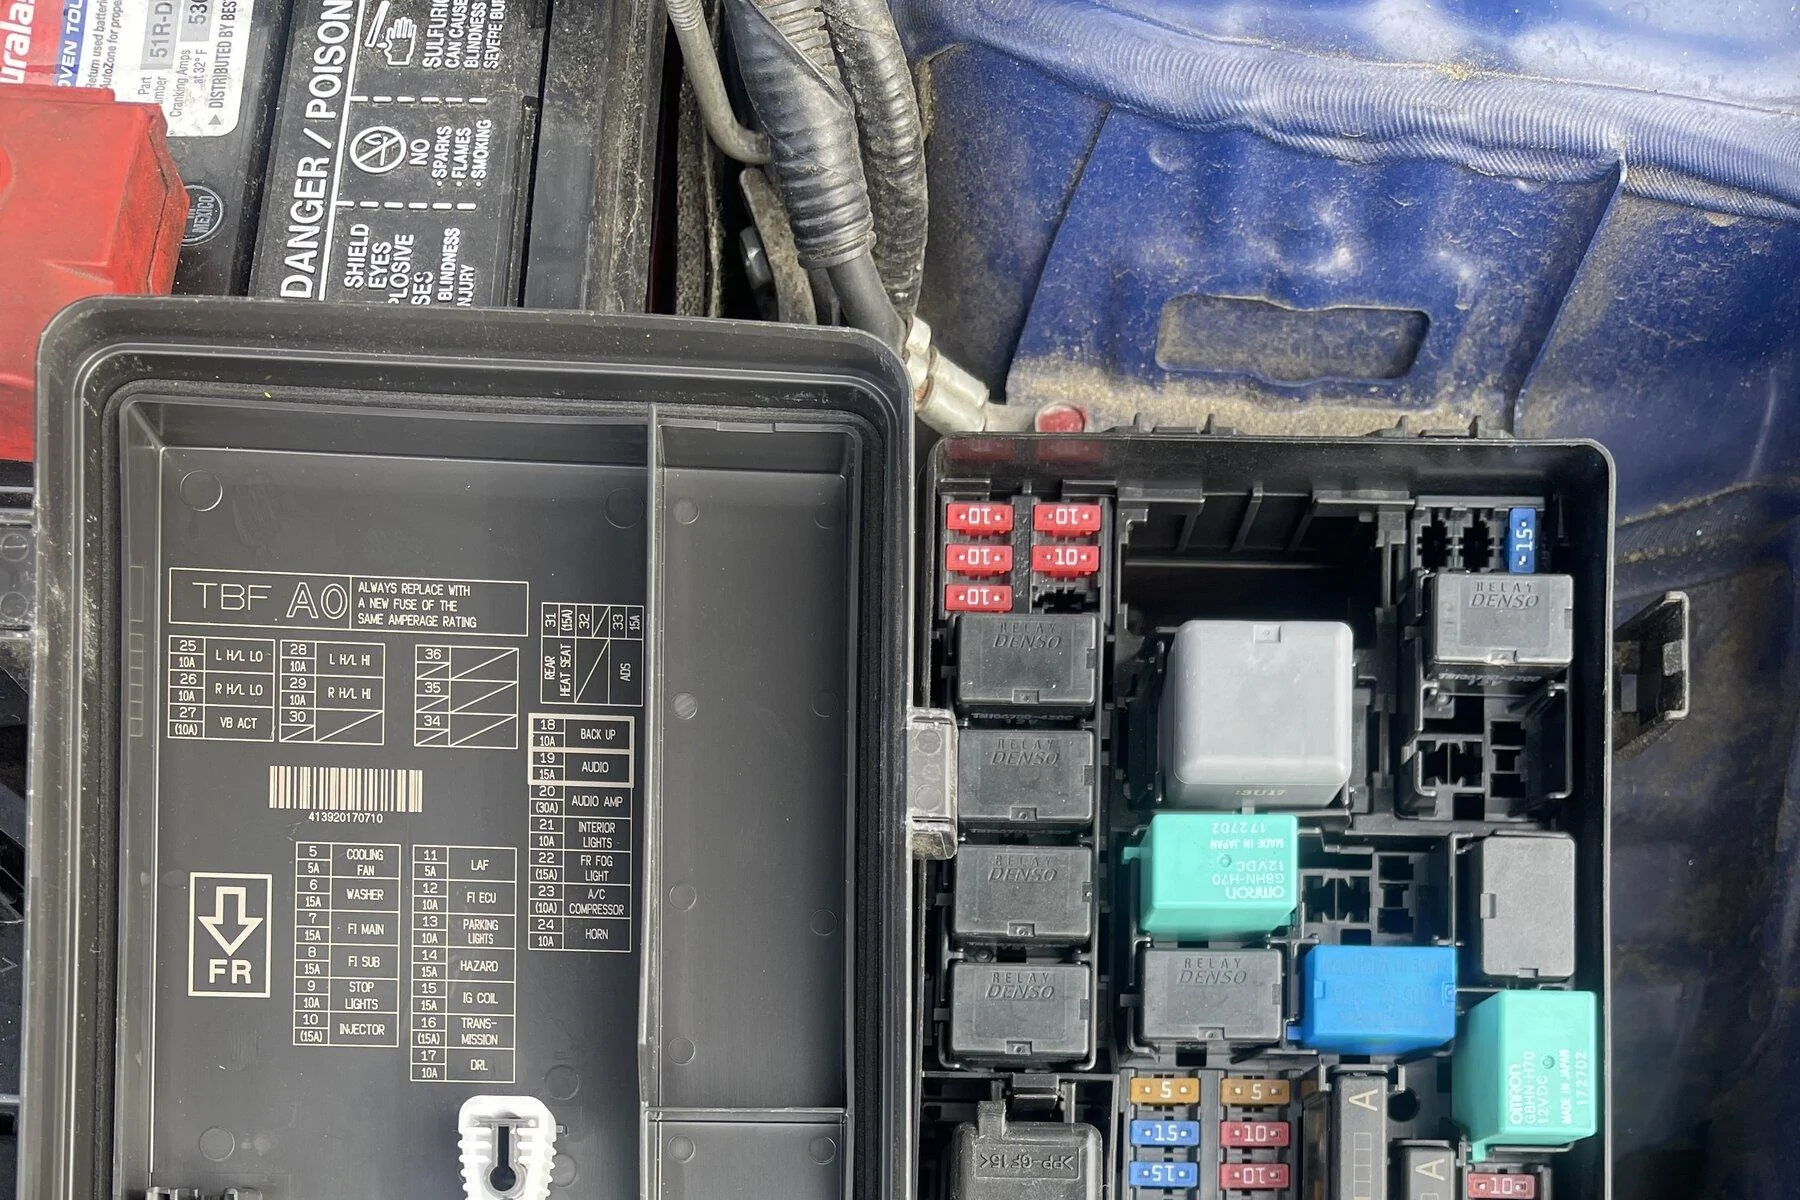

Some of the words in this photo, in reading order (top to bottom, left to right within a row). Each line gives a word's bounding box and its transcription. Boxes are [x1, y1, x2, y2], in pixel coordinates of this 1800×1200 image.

[221, 0, 237, 20] BES
[107, 30, 118, 43] for
[219, 24, 233, 37] BY
[463, 2, 486, 68] BLINDNESS
[0, 0, 35, 84] urala
[93, 35, 103, 56] used
[483, 24, 502, 69] SEVERE
[176, 50, 192, 73] Amps
[445, 42, 462, 68] CAN
[209, 41, 231, 108] DISTRIBUTED
[138, 77, 152, 94] Part
[170, 77, 188, 117] Cranking
[281, 156, 330, 298] DANGER
[306, 0, 351, 119] POISON
[410, 139, 430, 165] NO
[432, 126, 452, 178] SPARKS
[452, 128, 471, 178] FLAMES
[471, 119, 491, 178] SMOKING
[192, 195, 214, 233] MEXICO
[344, 224, 369, 288] SHIELD
[368, 242, 392, 289] EYES
[438, 228, 460, 301] BLINDNESS
[457, 264, 474, 306] NJURY
[968, 508, 990, 524] 10
[1056, 509, 1078, 524] 10
[1516, 529, 1532, 551] 15
[1054, 549, 1077, 565] 10
[192, 582, 272, 610] TBF
[359, 582, 397, 594] ALWAYS
[402, 583, 443, 595] REPLACE
[449, 584, 470, 596] WITH
[967, 589, 989, 605] 10
[1471, 594, 1539, 608] DENSO
[358, 598, 364, 608] A
[370, 599, 388, 610] NEW
[394, 599, 416, 610] FUSE
[422, 600, 434, 611] OF
[440, 601, 457, 612] THE
[358, 614, 383, 625] SAME
[388, 615, 439, 627] AMPERAGE
[443, 616, 476, 628] RATING
[562, 609, 573, 631] (15A)
[613, 614, 624, 630] 33
[180, 640, 196, 651] 25
[993, 634, 1063, 649] DENSO
[216, 650, 221, 661] L
[227, 650, 245, 662] H/L
[250, 651, 263, 662] LO
[330, 655, 335, 665] L
[340, 655, 357, 666] H/L
[362, 655, 370, 666] HI
[425, 650, 441, 660] 36
[560, 644, 571, 668] SEAT
[179, 657, 195, 668] 10A
[544, 656, 555, 680] REAR
[620, 663, 631, 682] ADS
[560, 671, 570, 696] HEAT
[180, 707, 196, 718] 27
[289, 711, 306, 722] 30
[175, 723, 197, 735] (10A)
[220, 717, 233, 728] VB
[238, 718, 257, 729] ACT
[541, 720, 555, 730] 18
[581, 729, 601, 740] BACK
[606, 729, 616, 740] UP
[991, 751, 1060, 766] DENSO
[582, 762, 609, 773] AUDIO
[572, 796, 599, 807] AUDIO
[604, 797, 623, 808] AMP
[308, 813, 383, 823] 413920170710
[579, 822, 615, 833] INTERIOR
[583, 837, 612, 848] LIGHTS
[1210, 839, 1239, 849] JAPAN
[1244, 839, 1253, 848] IN
[1258, 839, 1284, 848] MADE
[347, 849, 383, 860] COOLING
[581, 855, 591, 866] FR
[595, 856, 613, 867] FOG
[357, 865, 374, 876] FAN
[471, 860, 489, 870] LAF
[1236, 861, 1284, 872] 12VDC
[586, 871, 609, 881] LIGHT
[988, 868, 1057, 882] DENSO
[347, 889, 384, 900] WASHER
[467, 893, 476, 903] FI
[479, 893, 496, 903] ECU
[588, 889, 605, 899] A/C
[569, 904, 624, 915] COMPRESSOR
[348, 924, 358, 934] FI
[362, 924, 384, 935] MAIN
[463, 920, 499, 931] PARKING
[469, 934, 493, 944] LIGHTS
[586, 929, 608, 939] HORN
[349, 956, 358, 967] FI
[362, 957, 380, 967] SUB
[461, 961, 498, 972] HAZARD
[209, 959, 251, 984] FR
[1179, 970, 1247, 984] DENSO
[350, 982, 374, 993] STOP
[985, 985, 1054, 1000] DENSO
[345, 999, 378, 1010] LIGHTS
[463, 993, 472, 1003] IG
[477, 993, 498, 1004] COIL
[340, 1024, 385, 1035] INJECTOR
[461, 1018, 497, 1029] TRANS-
[462, 1035, 498, 1045] MISSION
[471, 1060, 488, 1071] DRL
[1161, 1082, 1171, 1098] 5
[1251, 1084, 1262, 1100] 5
[1349, 1089, 1378, 1111] A
[1155, 1125, 1177, 1141] 15
[1244, 1125, 1266, 1141] 10
[1416, 1158, 1446, 1181] A
[1490, 1177, 1513, 1194] 10
